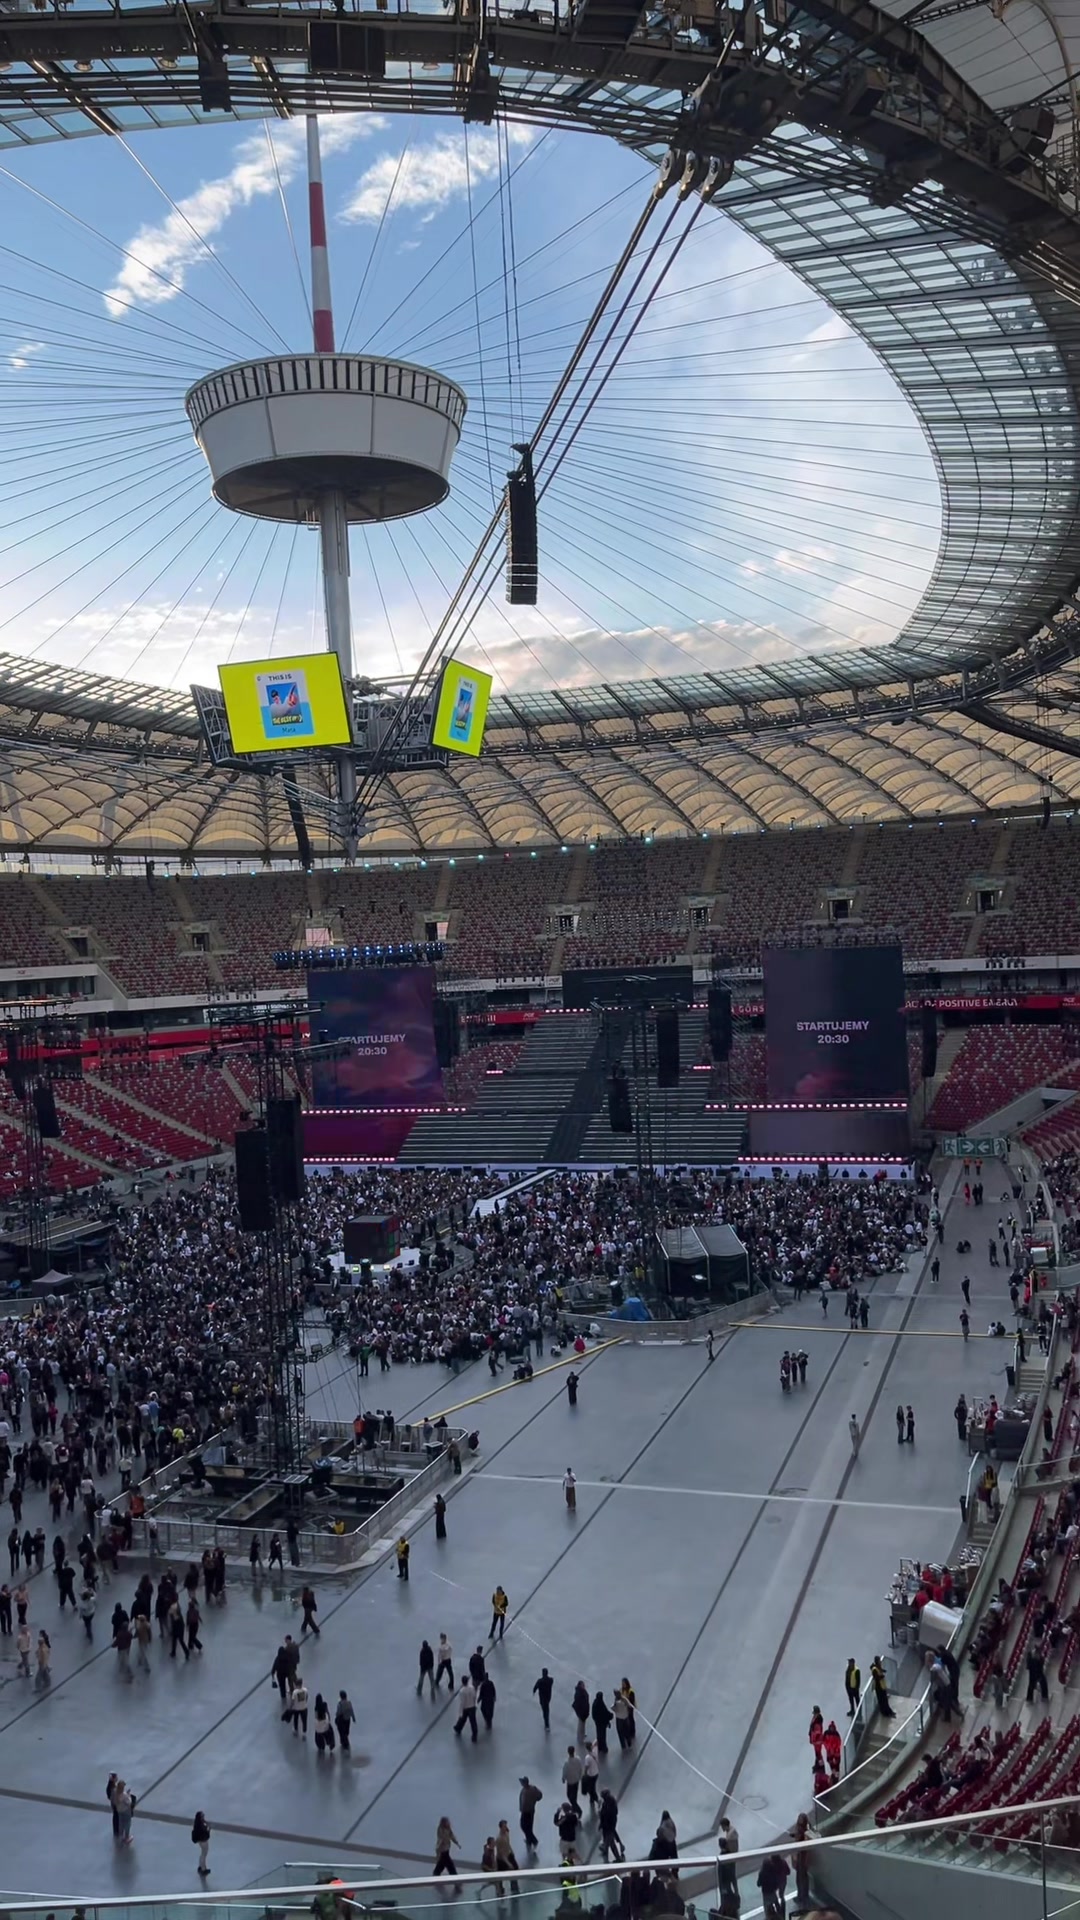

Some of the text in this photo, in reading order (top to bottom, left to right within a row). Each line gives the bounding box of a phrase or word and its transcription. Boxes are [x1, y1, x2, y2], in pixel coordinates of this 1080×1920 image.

[938, 999, 981, 1008] POSITIVE
[797, 1020, 869, 1031] STARTUJEMY
[337, 1033, 407, 1045] STARTUJEMY
[817, 1034, 850, 1044] 20:30
[357, 1046, 388, 1056] 20:30
